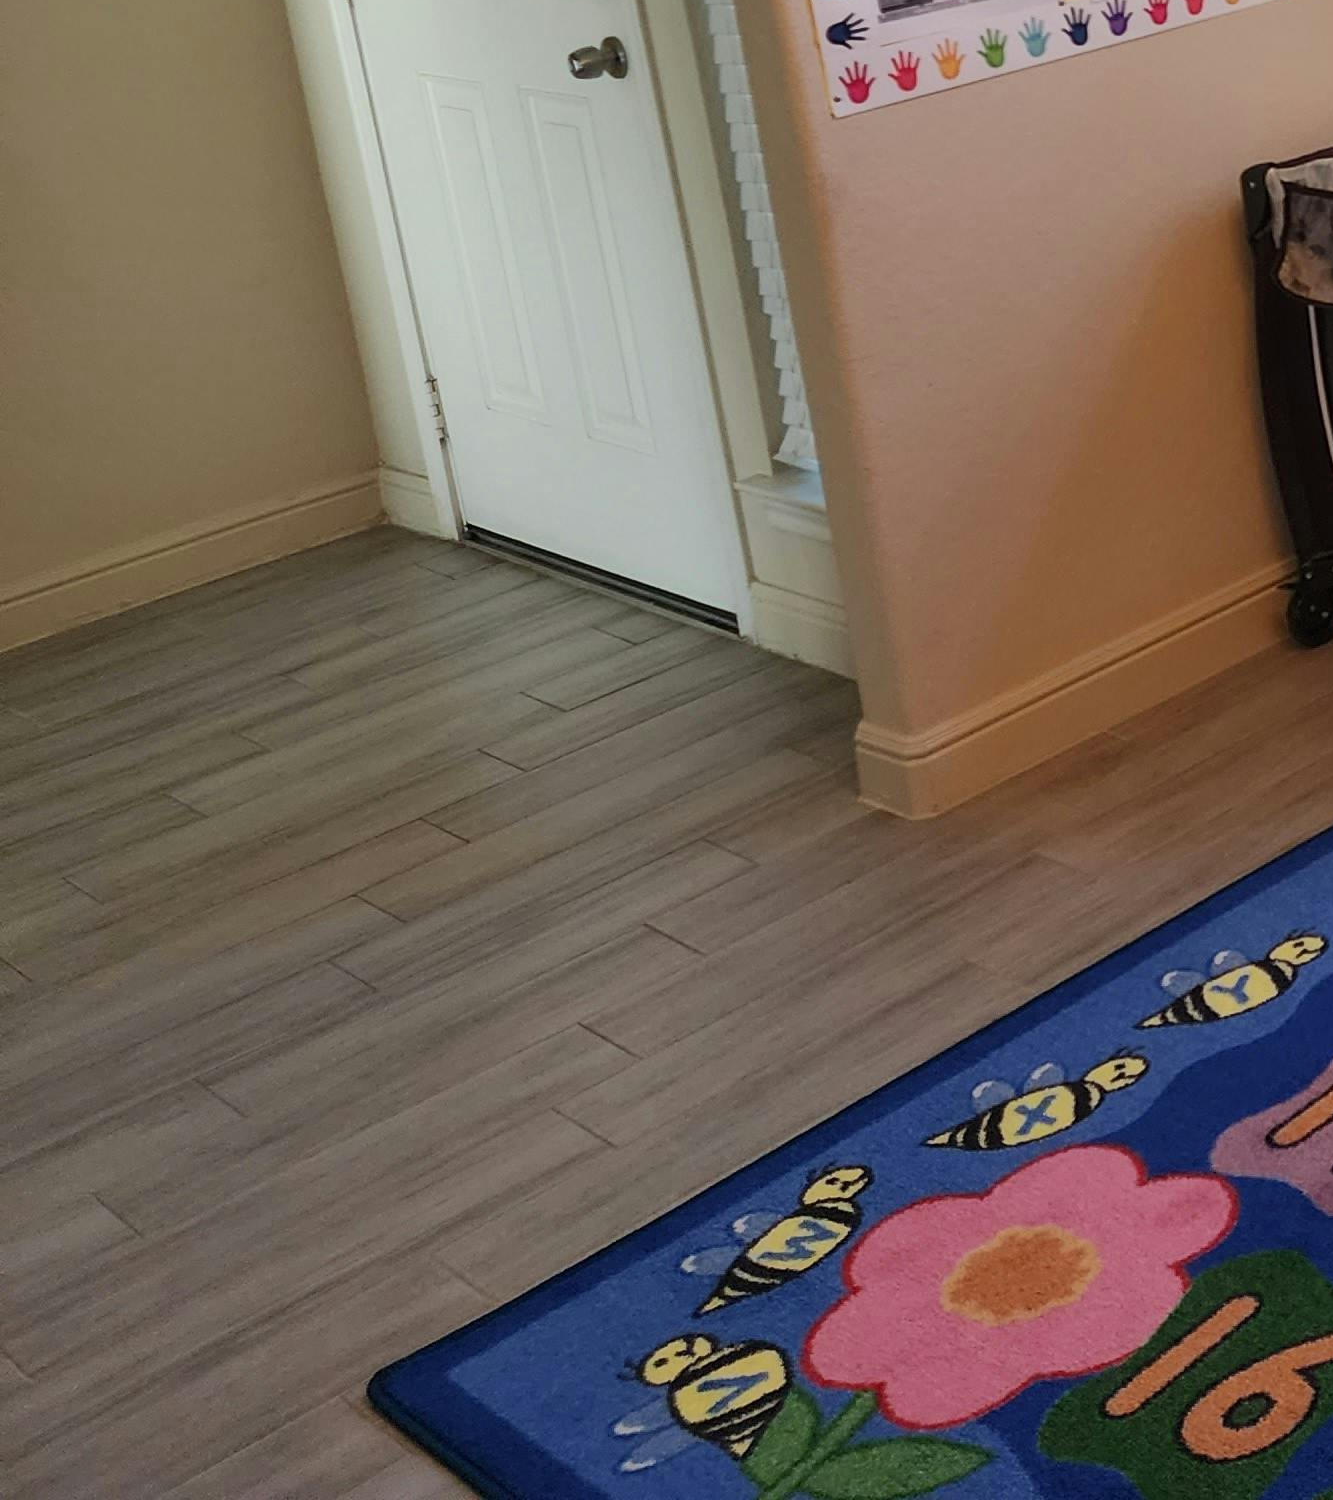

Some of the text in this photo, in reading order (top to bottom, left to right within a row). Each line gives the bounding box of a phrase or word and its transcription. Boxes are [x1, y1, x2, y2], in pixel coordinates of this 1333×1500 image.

[1210, 974, 1255, 1004] Y
[1013, 1095, 1060, 1133] X
[756, 1219, 840, 1261] W
[696, 1370, 770, 1415] V
